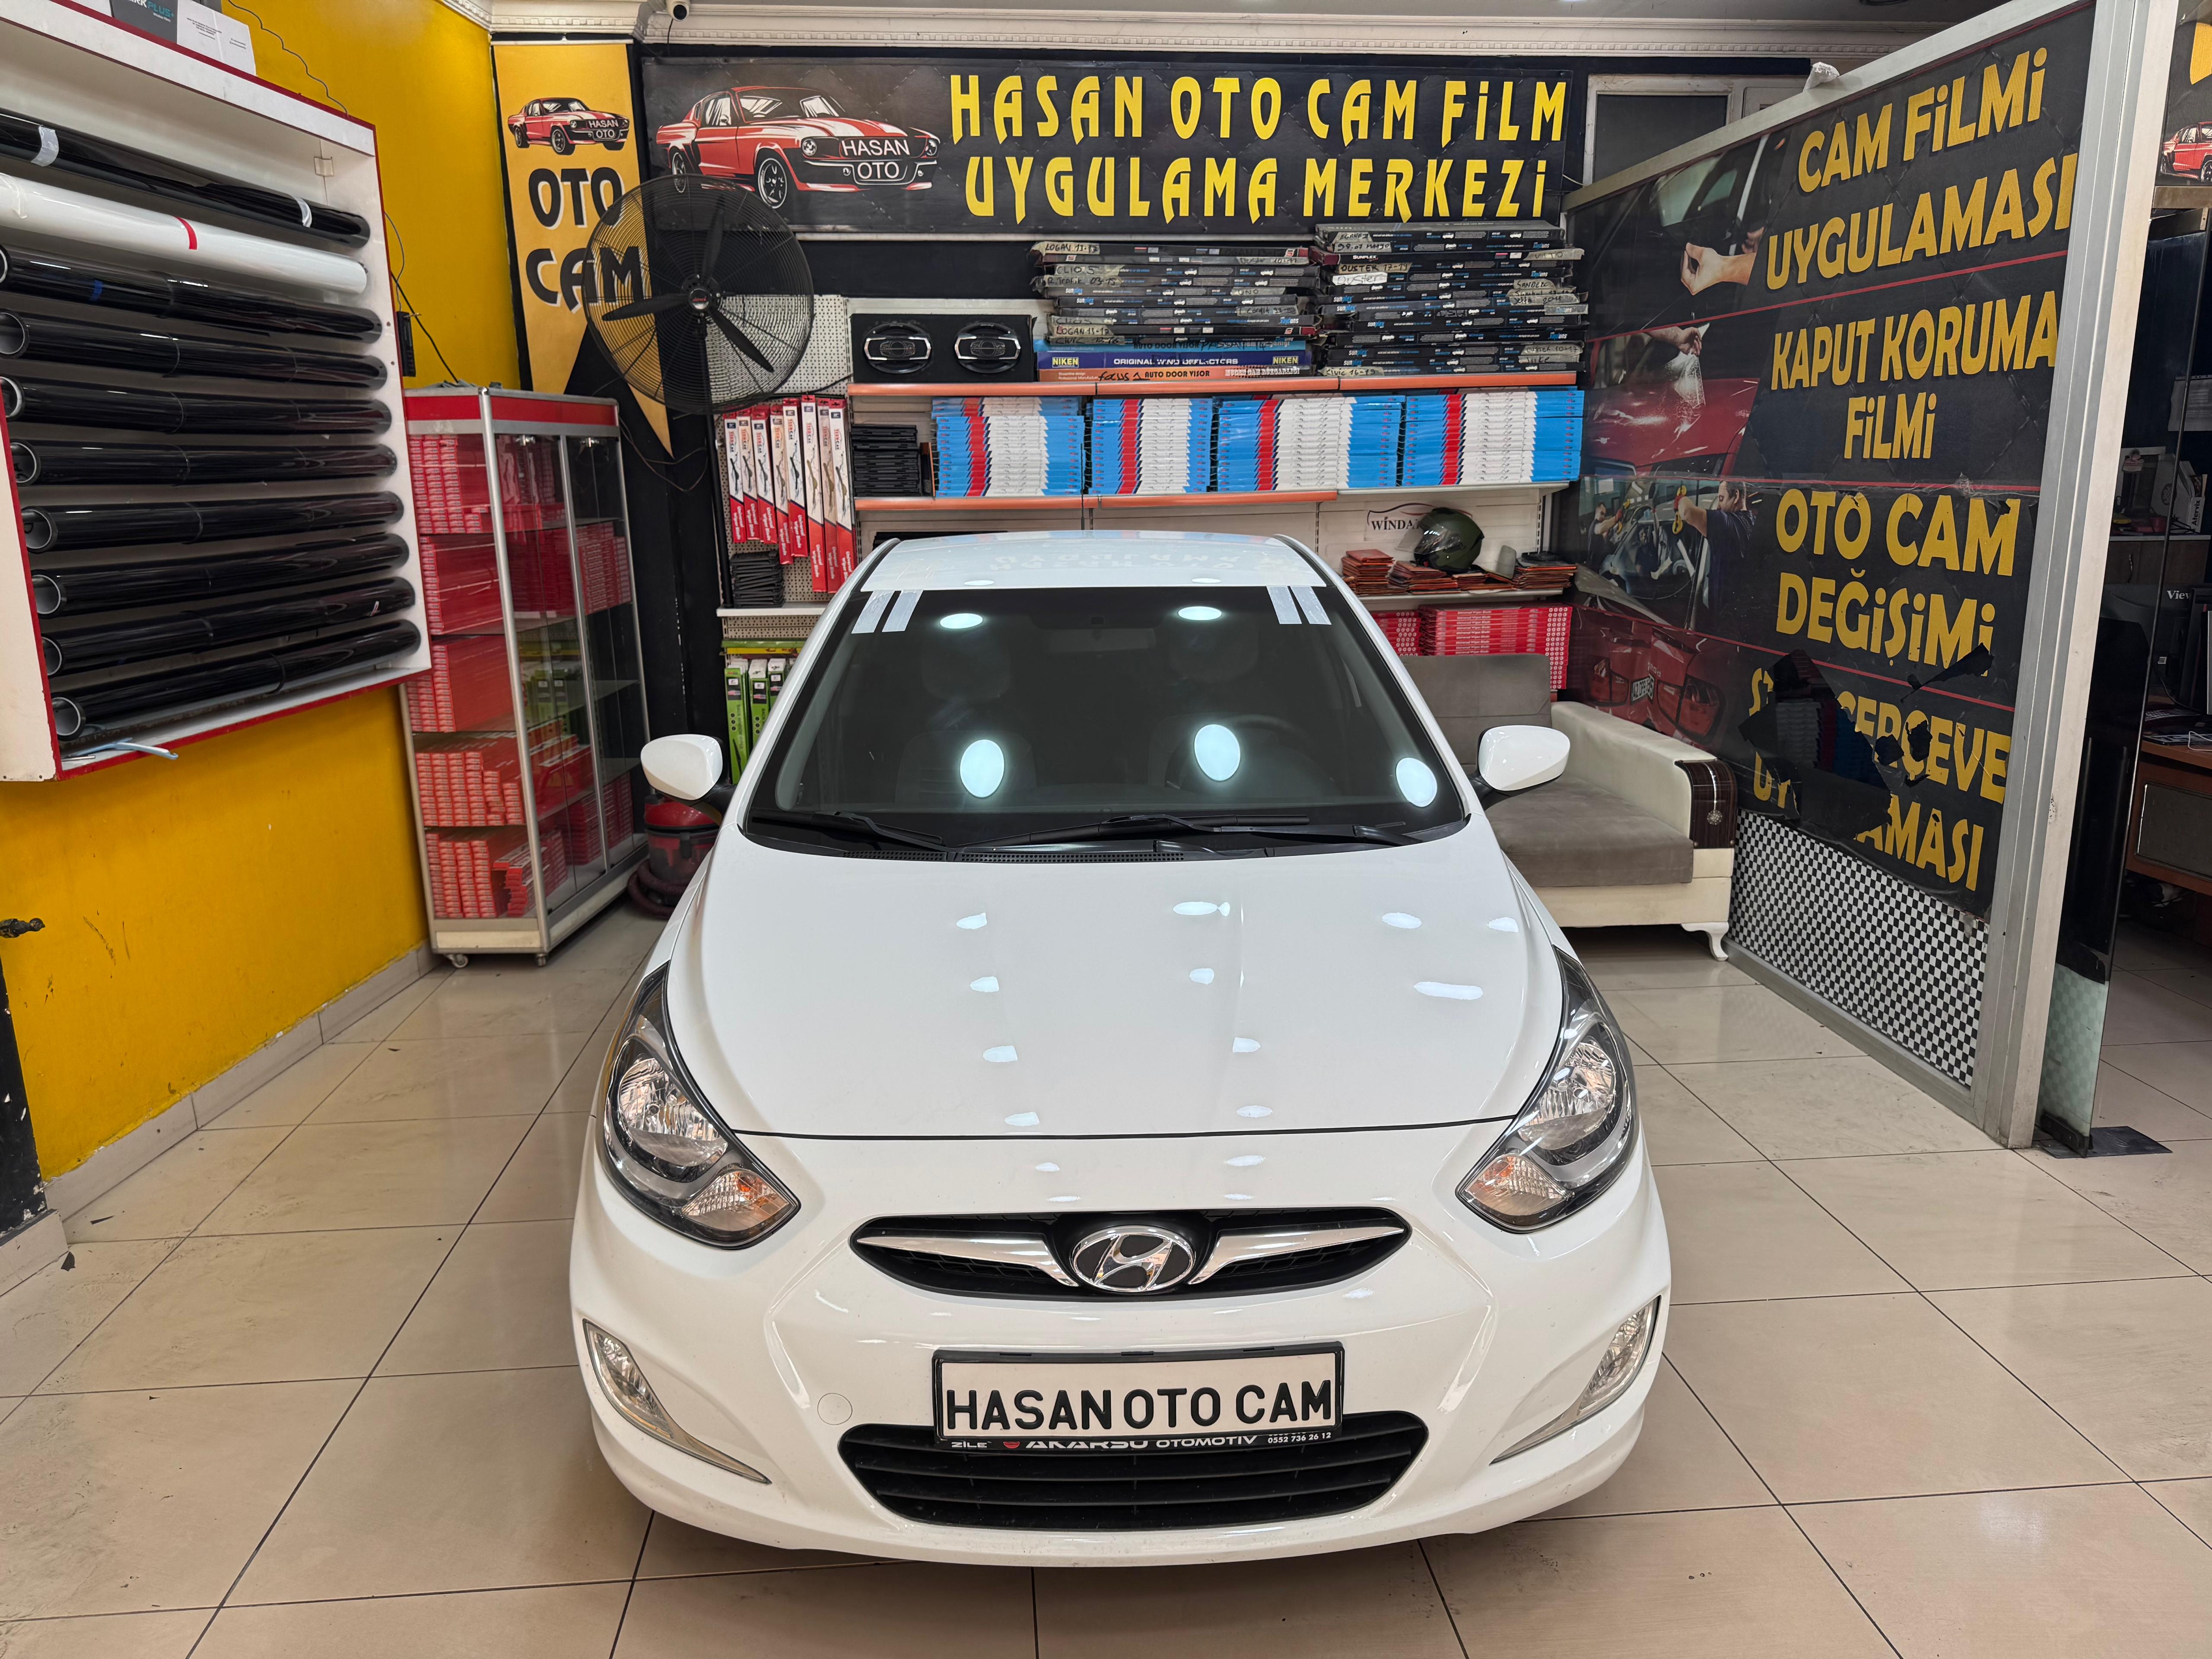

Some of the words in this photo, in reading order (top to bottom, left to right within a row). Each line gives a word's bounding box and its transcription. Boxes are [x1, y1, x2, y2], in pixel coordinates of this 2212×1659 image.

[588, 119, 619, 128] HASAN
[596, 130, 615, 138] OTO
[951, 75, 1142, 144] HASAN
[1171, 76, 1281, 140] OTO
[1308, 79, 1417, 146] CAM
[842, 140, 910, 156] HASAN
[858, 162, 899, 179] OTO
[1798, 103, 1892, 192] CAM
[529, 167, 623, 227] OTO
[966, 157, 1278, 224] UYGULAMA
[1767, 153, 2078, 289] UYGULAMASI
[526, 246, 645, 311] CAM
[1771, 318, 1875, 390] KAPUT
[1880, 291, 2058, 381] KORUMA
[1776, 489, 1871, 559] OTO
[1886, 493, 2021, 576] CAM
[947, 1389, 1112, 1430] HASAN
[1124, 1387, 1220, 1428] OTO
[1236, 1380, 1331, 1424] CAM
